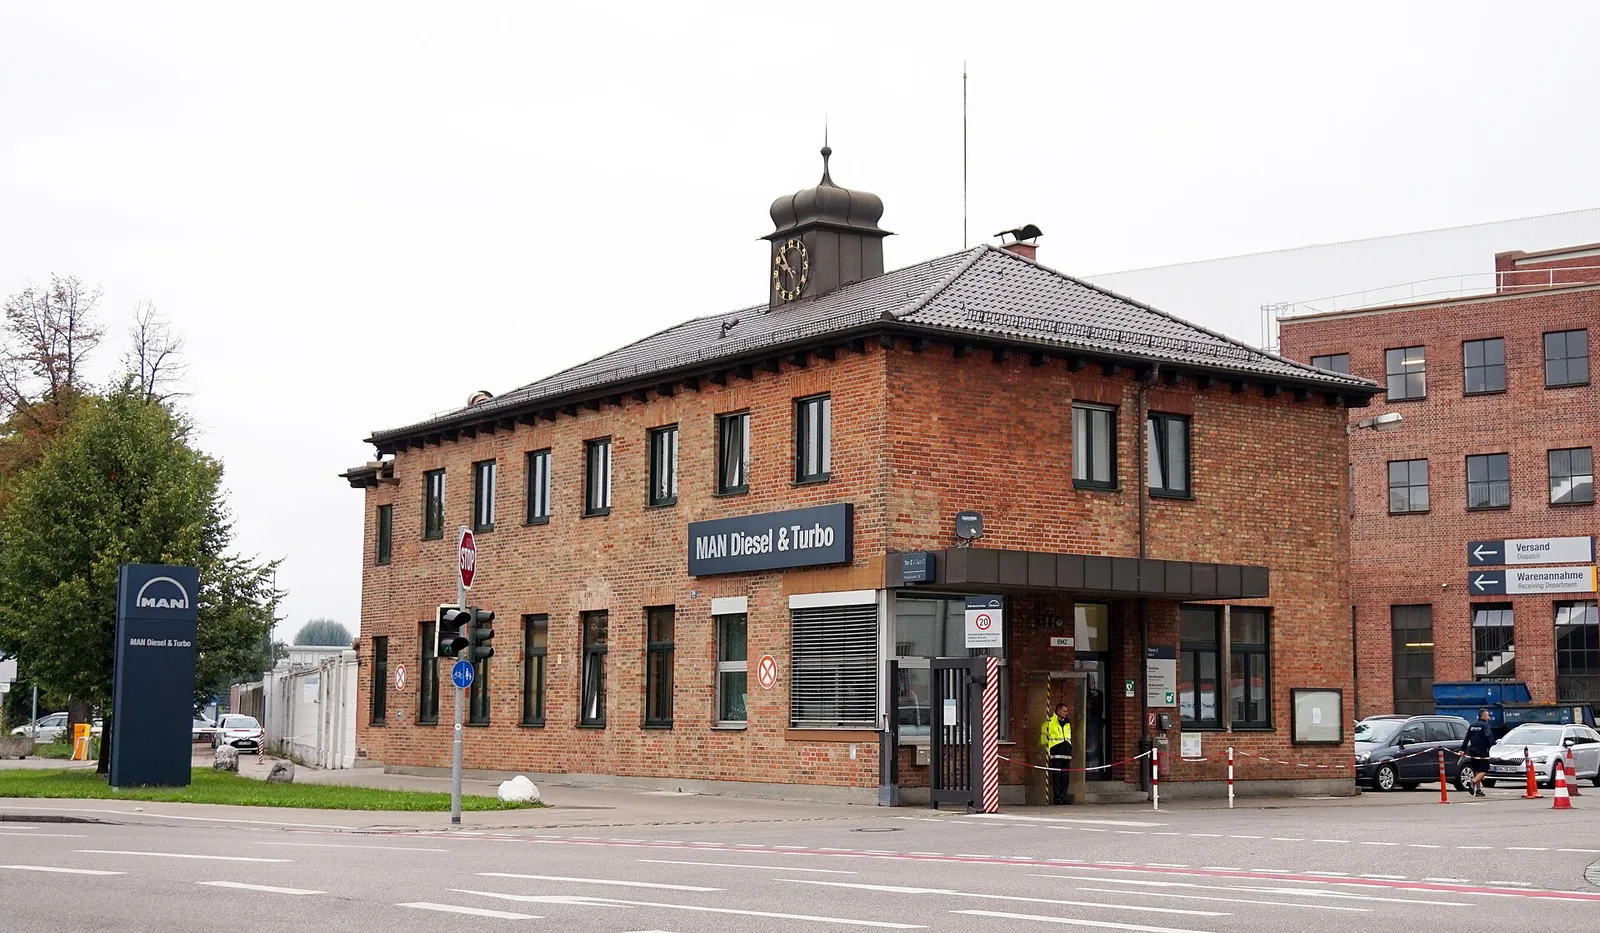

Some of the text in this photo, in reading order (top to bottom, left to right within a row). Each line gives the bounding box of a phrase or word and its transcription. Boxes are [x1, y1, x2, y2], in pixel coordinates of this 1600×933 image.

[696, 522, 834, 560] MAN Diesel & Turbo
[1516, 542, 1550, 552] Versand
[460, 547, 475, 571] STOP
[1517, 571, 1584, 581] Warenannahme
[1518, 581, 1578, 590] Receiving Department
[141, 597, 185, 609] MAN
[979, 617, 989, 627] 20
[130, 638, 191, 647] MAN Diesel & Turbo
